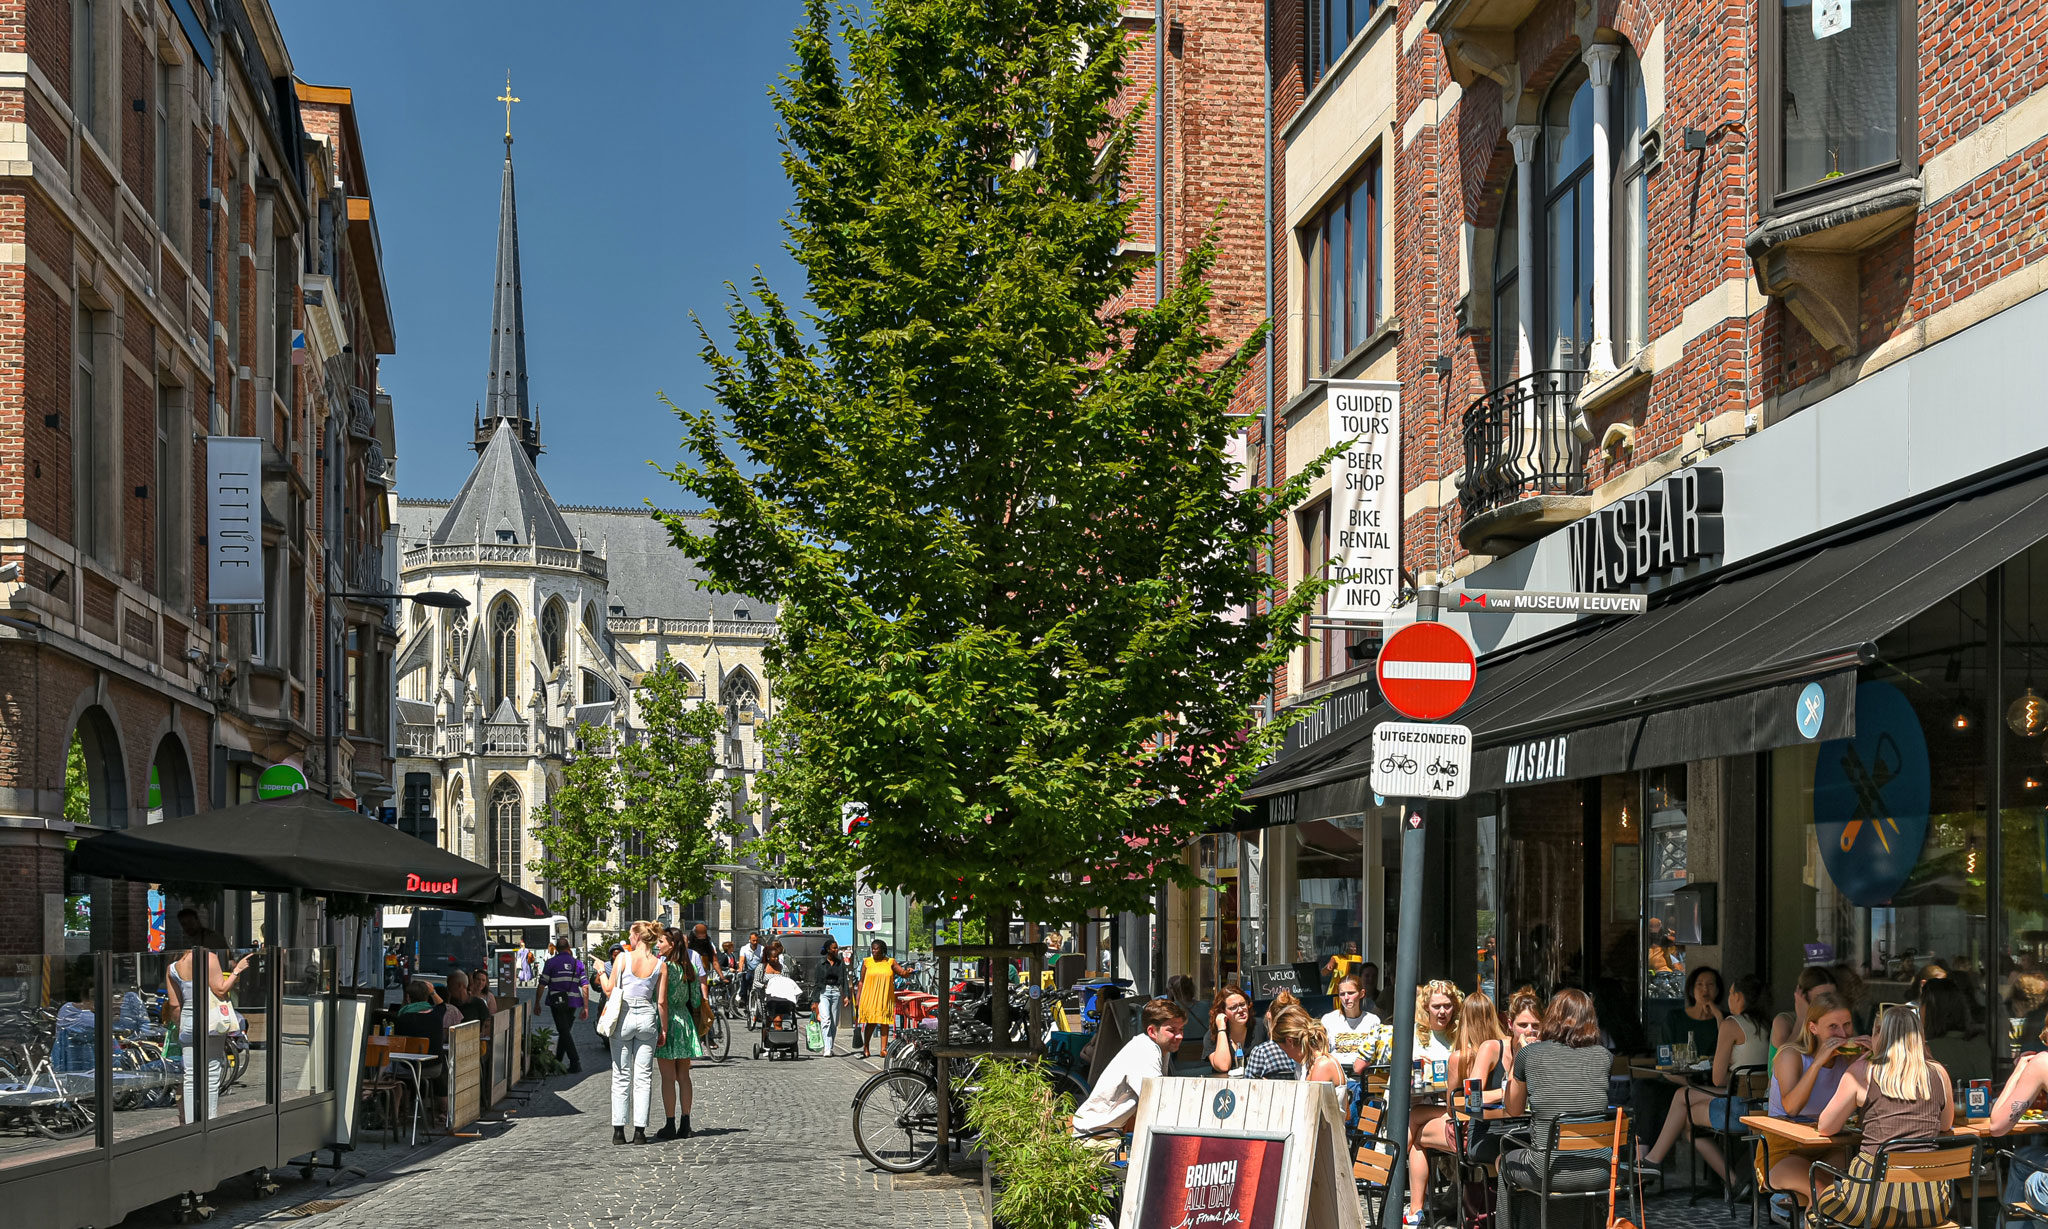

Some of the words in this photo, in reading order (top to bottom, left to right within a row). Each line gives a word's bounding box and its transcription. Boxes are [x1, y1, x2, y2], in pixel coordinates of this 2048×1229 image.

[1336, 394, 1393, 413] GUIDED
[1340, 415, 1389, 434] TOURS
[1348, 451, 1382, 470] BEER
[1345, 473, 1384, 491] SHOP
[219, 472, 250, 568] LETTUCE
[1349, 509, 1380, 527] BIKE
[1566, 466, 1704, 592] WASBAR
[1339, 530, 1391, 549] RENTAL
[1334, 566, 1394, 585] TOURIST
[1346, 588, 1381, 606] INFO
[1491, 599, 1510, 608] VAN
[1514, 595, 1579, 609] MUSEUM
[1583, 597, 1641, 611] LEUVEN
[1379, 730, 1467, 746] UITGEZONDERD
[1505, 737, 1567, 783] WASBAR
[259, 782, 292, 791] Lapperre
[1447, 780, 1455, 791] P
[406, 873, 459, 894] Duvel
[1185, 1159, 1238, 1188] BRUNCH
[1184, 1186, 1206, 1211] ALL
[1207, 1183, 1235, 1209] DAY
